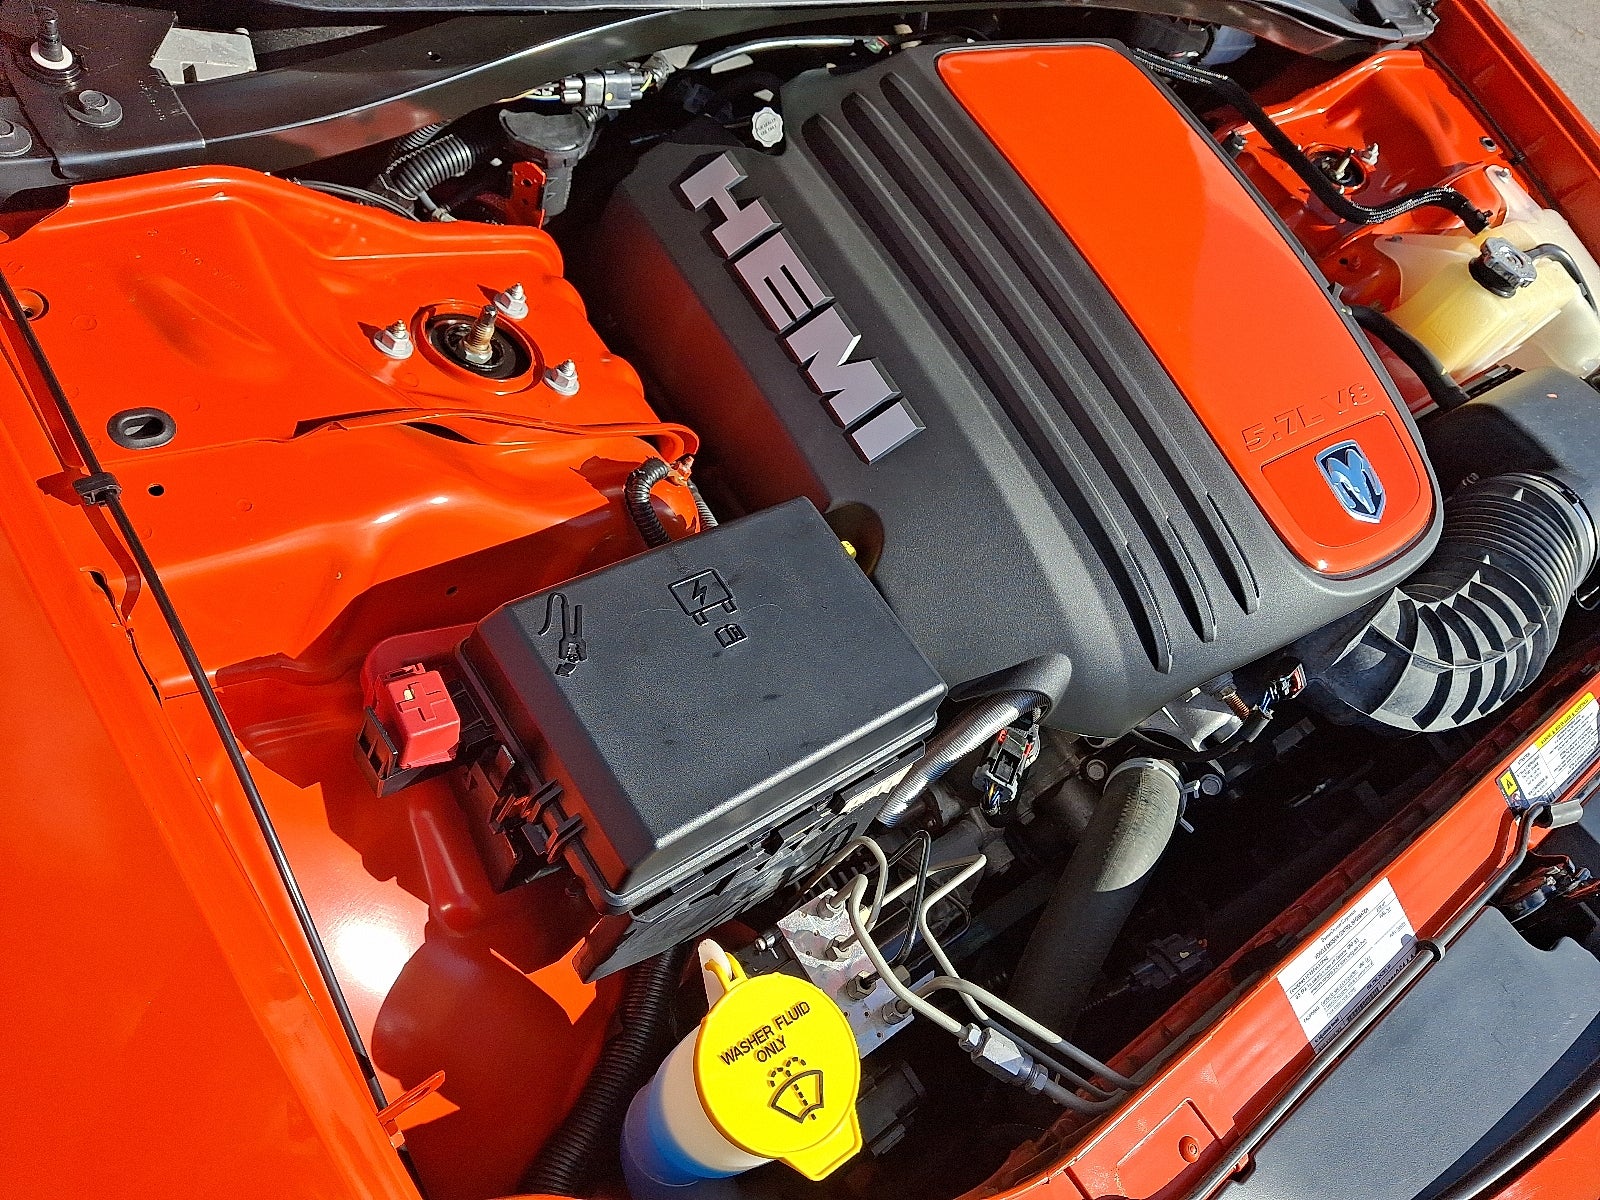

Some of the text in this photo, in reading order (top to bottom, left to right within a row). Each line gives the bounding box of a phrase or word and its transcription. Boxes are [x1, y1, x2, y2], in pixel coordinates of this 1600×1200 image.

[680, 152, 926, 465] HEMI
[1241, 383, 1375, 453] 5.7L V8
[719, 1001, 811, 1066] WASHER FLUID
[755, 1035, 787, 1063] ONLY
